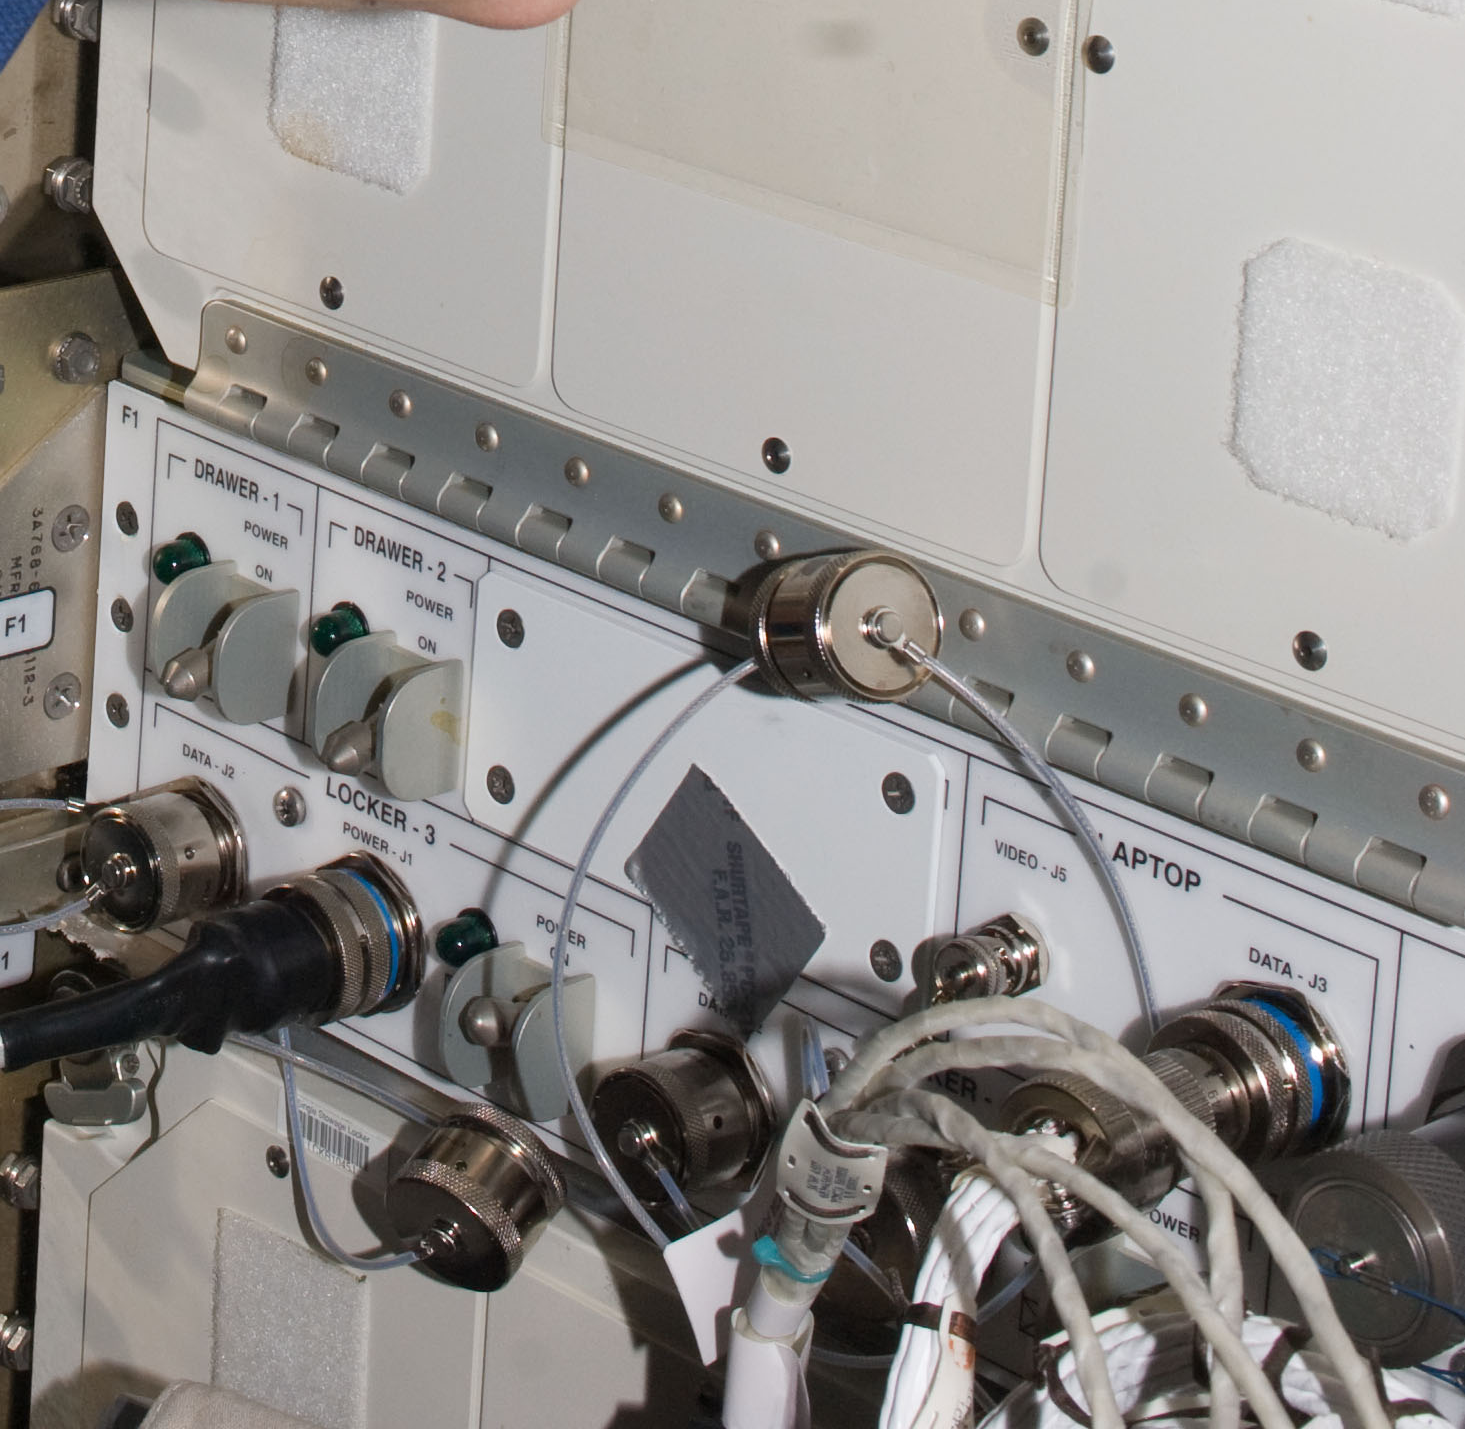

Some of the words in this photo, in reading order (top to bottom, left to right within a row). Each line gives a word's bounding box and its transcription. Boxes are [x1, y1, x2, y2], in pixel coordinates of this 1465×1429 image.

[121, 404, 139, 429] F1
[194, 457, 260, 504] DRAWER
[273, 491, 280, 512] 1
[244, 519, 289, 551] POWER
[353, 524, 424, 574] DRAWER
[436, 560, 447, 584] 2
[9, 555, 23, 593] MFR
[254, 564, 274, 584] ON
[405, 589, 454, 623] POWER
[4, 613, 27, 638] F1
[417, 634, 438, 655] ON
[182, 742, 213, 771] DATA
[221, 762, 236, 780] J2
[325, 775, 408, 834] LOCKER
[423, 823, 437, 847] 3
[341, 821, 390, 857] POWER
[399, 846, 414, 866] J1
[994, 839, 1039, 870] VIDEO
[1049, 863, 1068, 883] J5
[1108, 839, 1202, 893] APTOP
[536, 913, 587, 950] POER
[1248, 946, 1294, 981] DATA
[1307, 972, 1329, 993] J3
[1148, 1207, 1201, 1244] OWER
